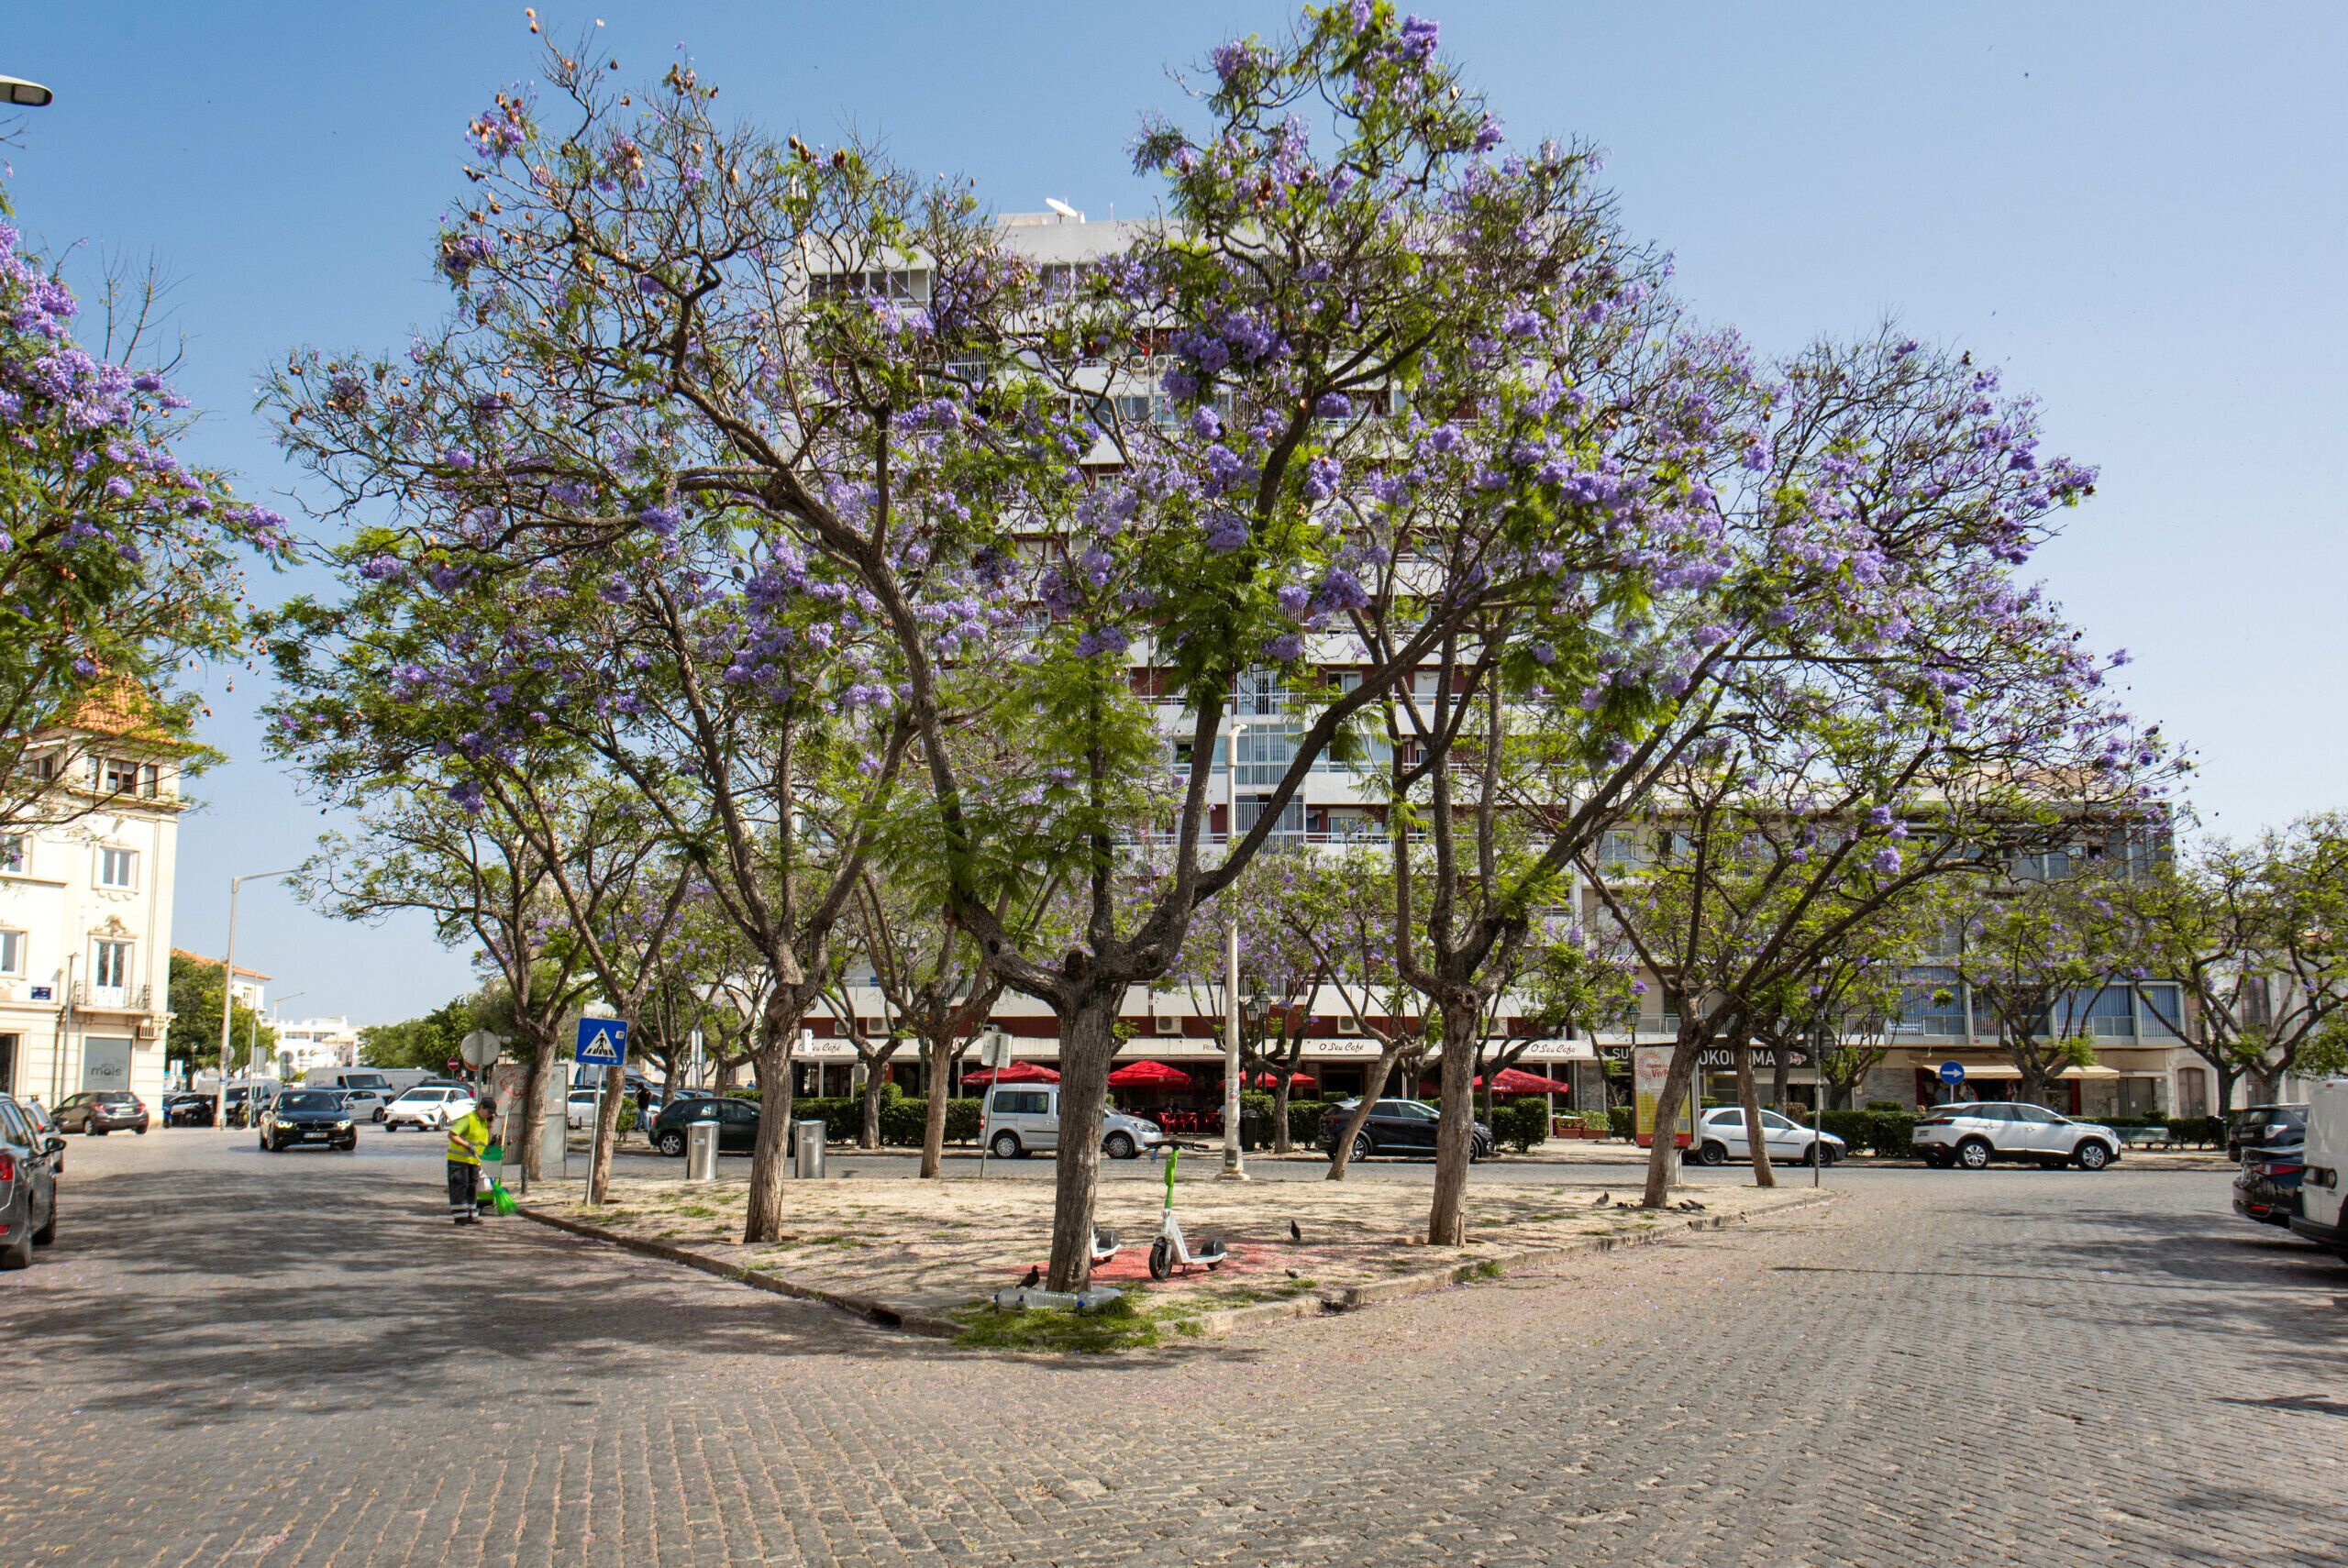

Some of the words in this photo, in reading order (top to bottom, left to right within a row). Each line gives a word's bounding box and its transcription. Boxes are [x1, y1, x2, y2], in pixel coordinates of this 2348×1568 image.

[1319, 1043, 1327, 1051] O
[1328, 1043, 1343, 1051] Seu
[1531, 1043, 1539, 1053] O
[1539, 1044, 1555, 1053] Seu
